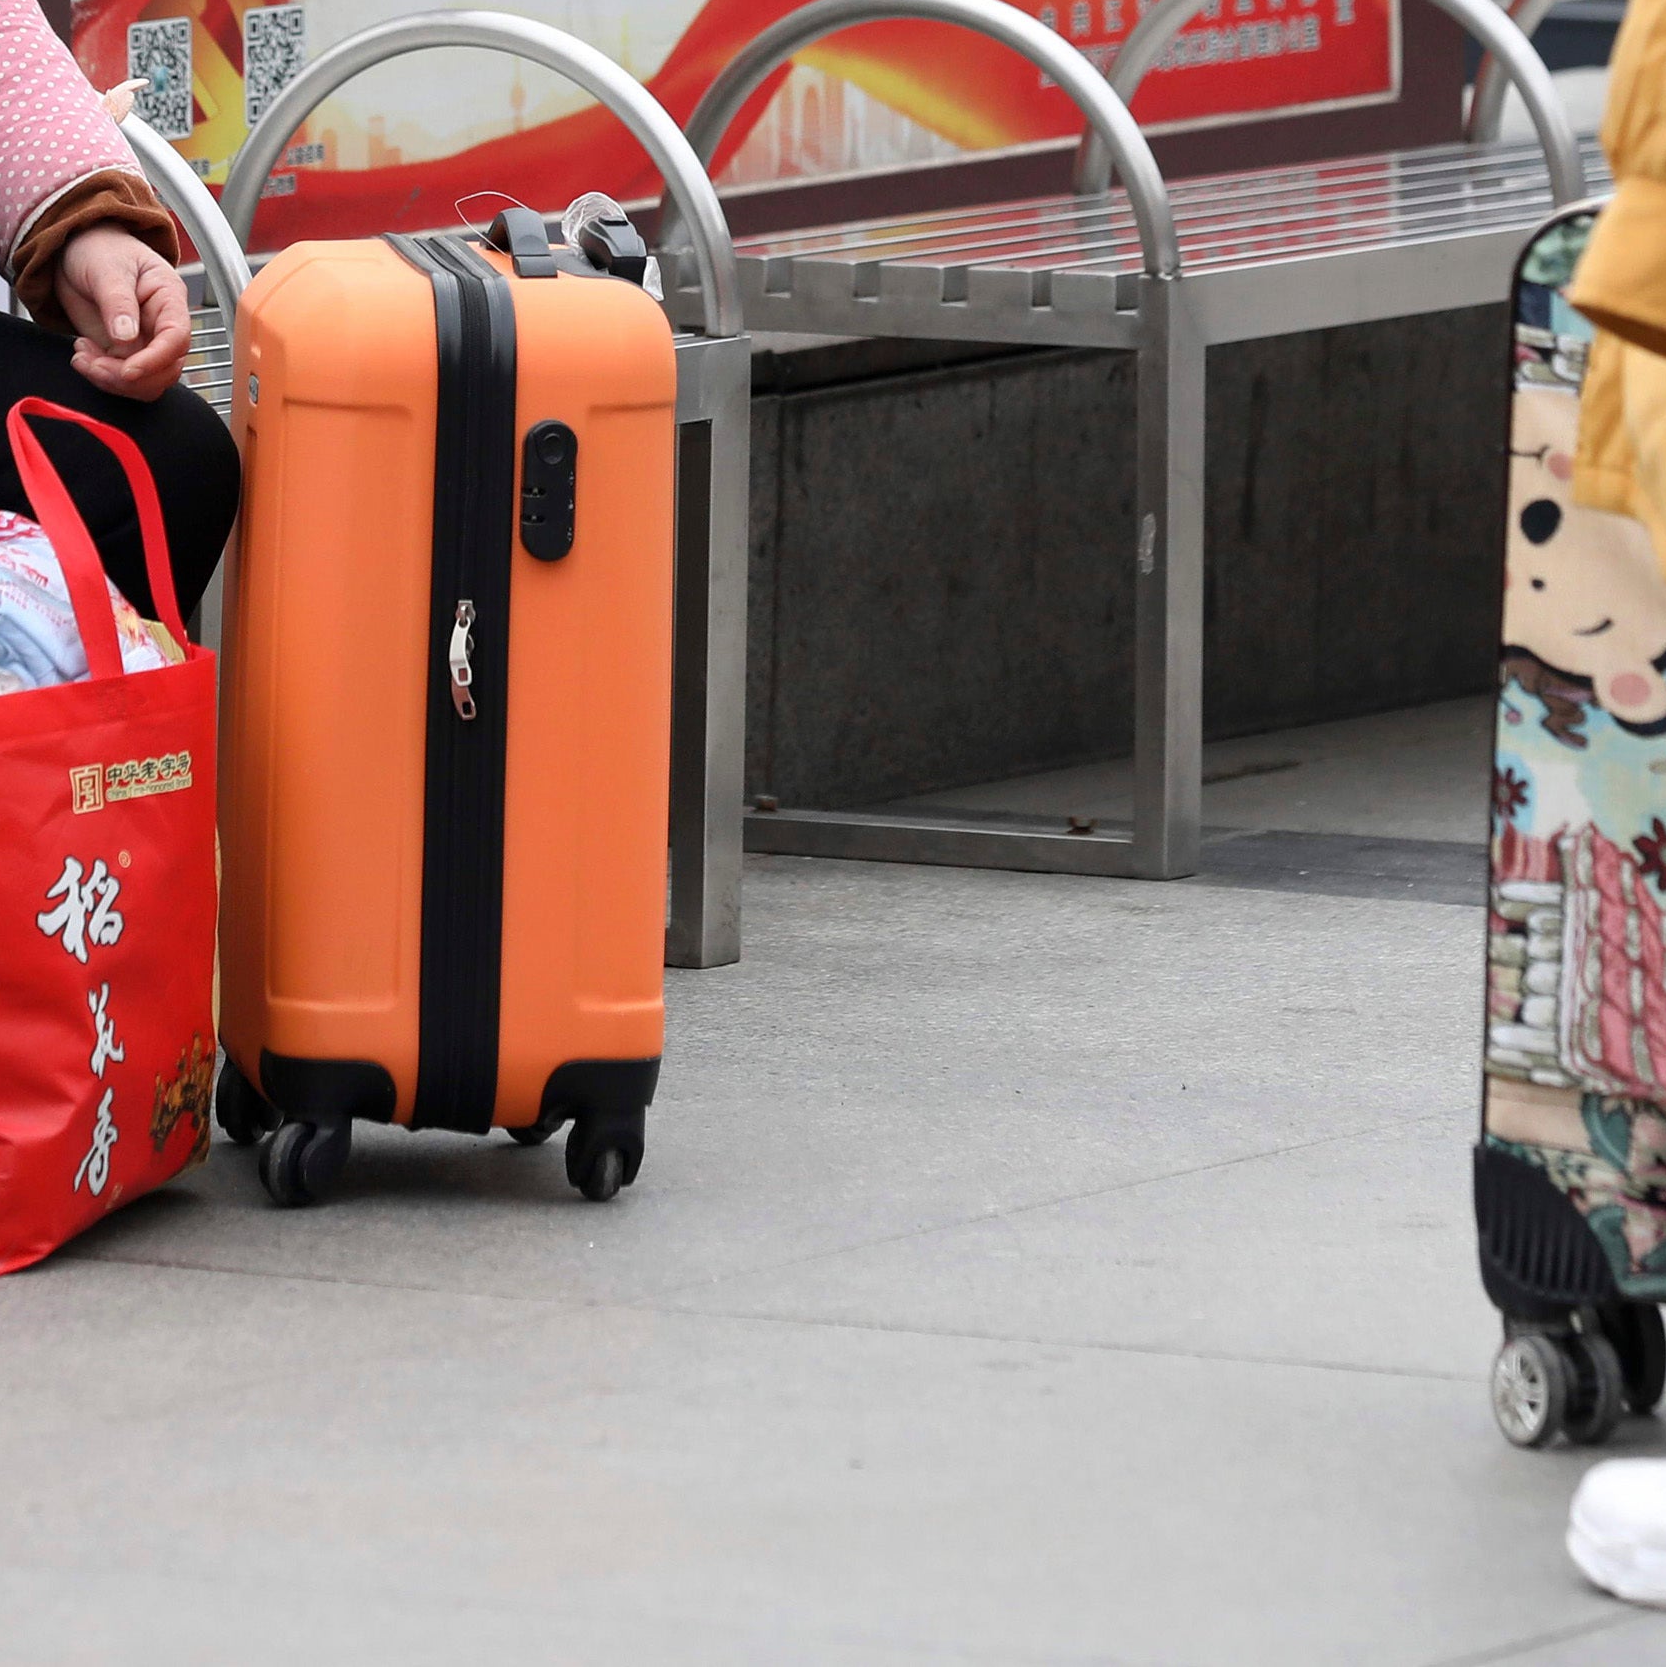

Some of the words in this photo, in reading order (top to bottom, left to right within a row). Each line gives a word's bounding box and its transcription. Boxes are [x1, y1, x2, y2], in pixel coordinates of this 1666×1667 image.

[107, 751, 191, 788] 中华老字号
